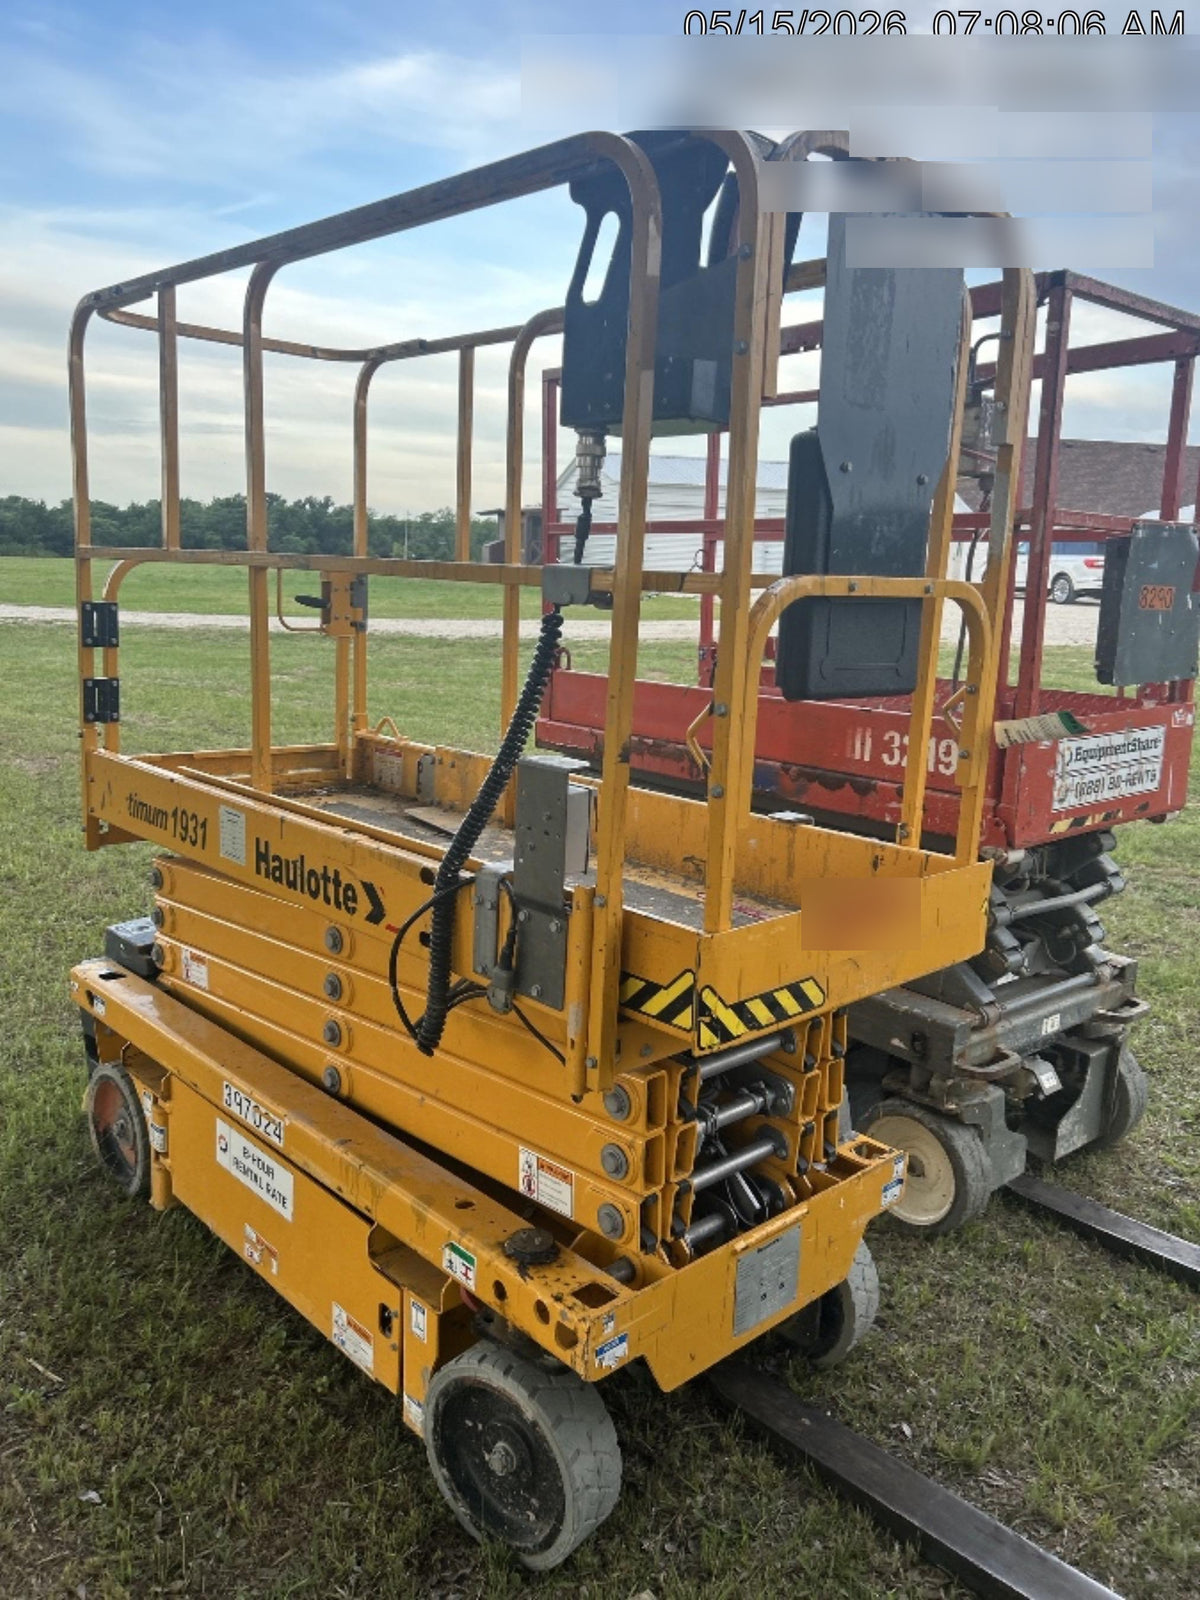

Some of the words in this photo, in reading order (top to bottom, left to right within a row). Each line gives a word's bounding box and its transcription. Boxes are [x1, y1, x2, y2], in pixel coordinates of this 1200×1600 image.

[171, 806, 208, 850] 1931
[255, 836, 358, 916] Haulotte
[224, 1083, 283, 1145] 397024
